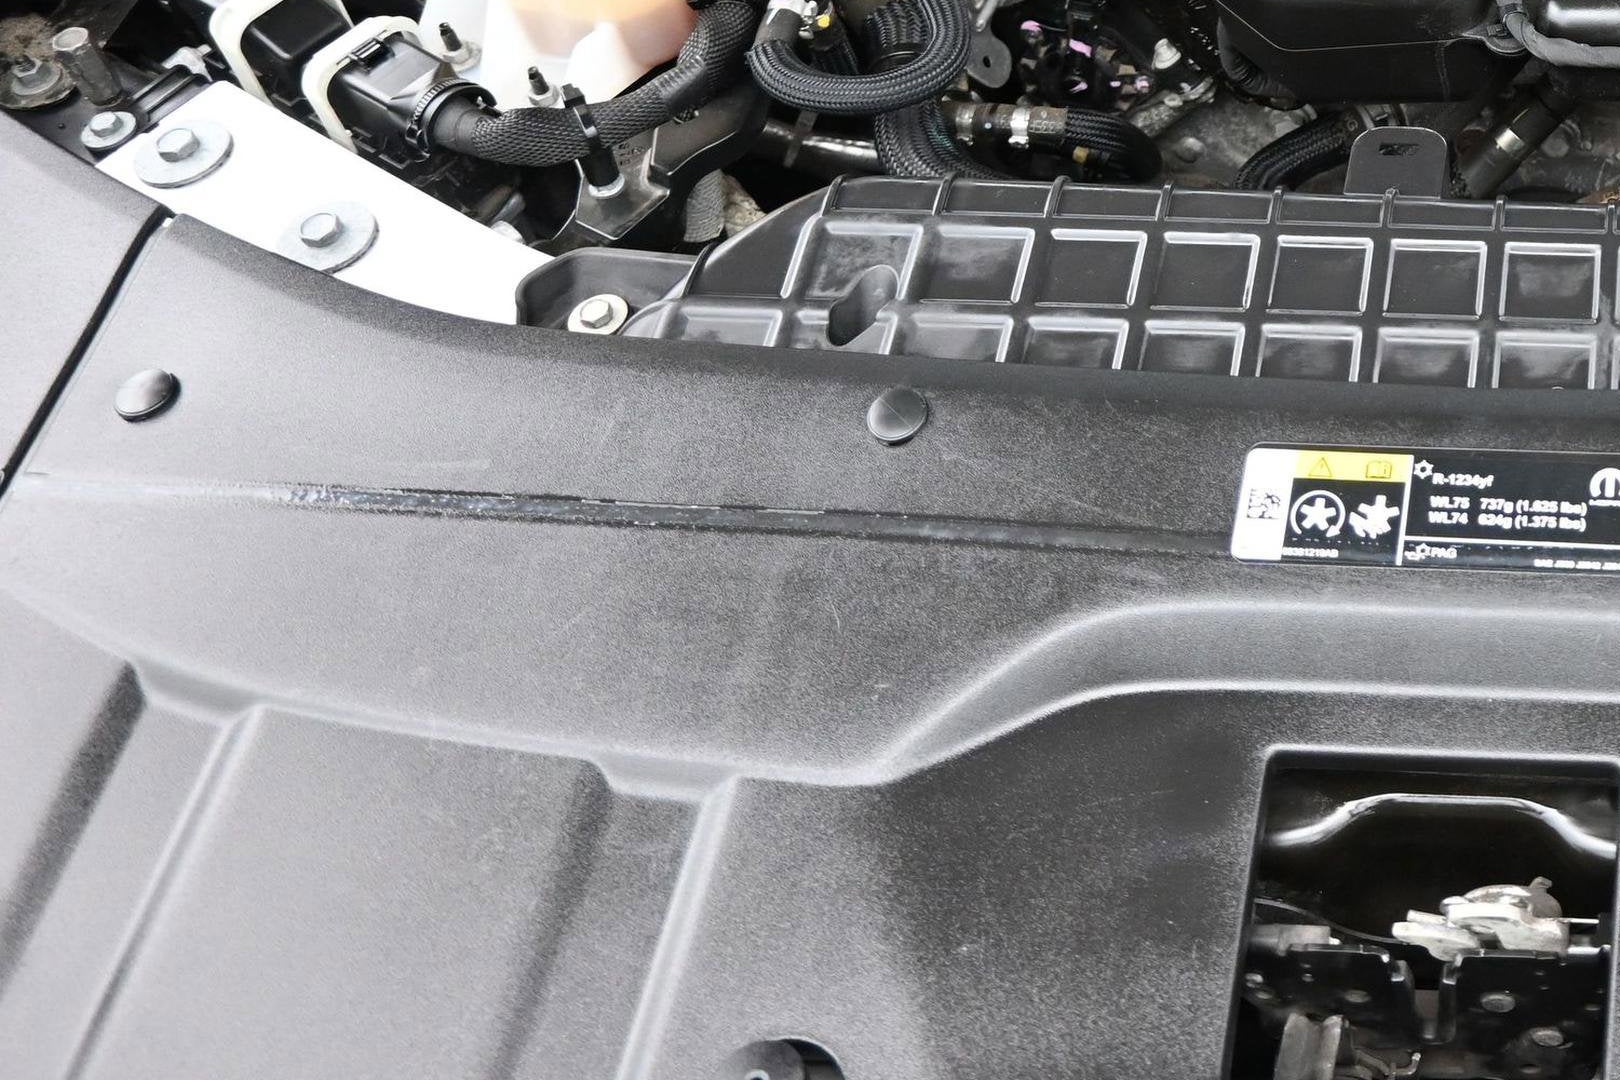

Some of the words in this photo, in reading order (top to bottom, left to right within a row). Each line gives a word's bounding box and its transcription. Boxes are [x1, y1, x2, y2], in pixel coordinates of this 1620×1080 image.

[1431, 472, 1495, 490] R-1234yf
[1429, 495, 1471, 510] WL75
[1479, 497, 1514, 514] 737g
[1428, 510, 1469, 525] WL74
